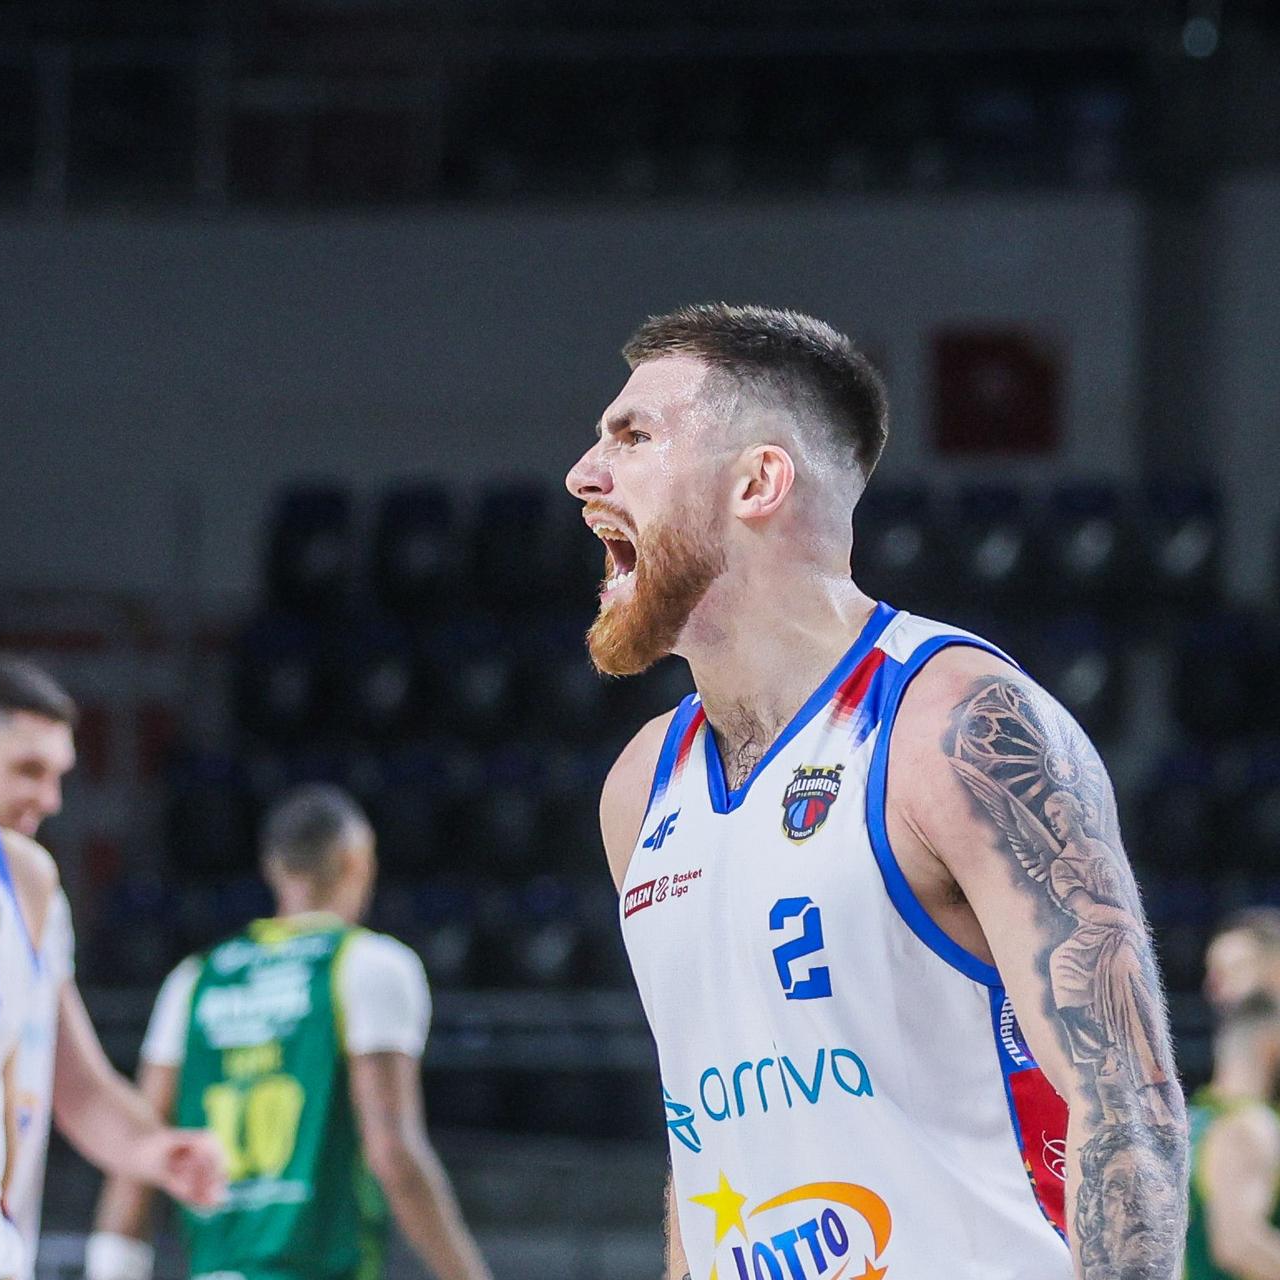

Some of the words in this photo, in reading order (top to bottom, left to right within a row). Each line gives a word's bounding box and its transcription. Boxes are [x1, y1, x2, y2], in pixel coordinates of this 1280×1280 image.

[787, 778, 840, 798] TWARDE
[671, 885, 689, 898] Liga
[672, 868, 702, 884] Basket
[769, 897, 832, 999] 2
[1000, 996, 1028, 1066] TWARD
[698, 1041, 873, 1123] arriva
